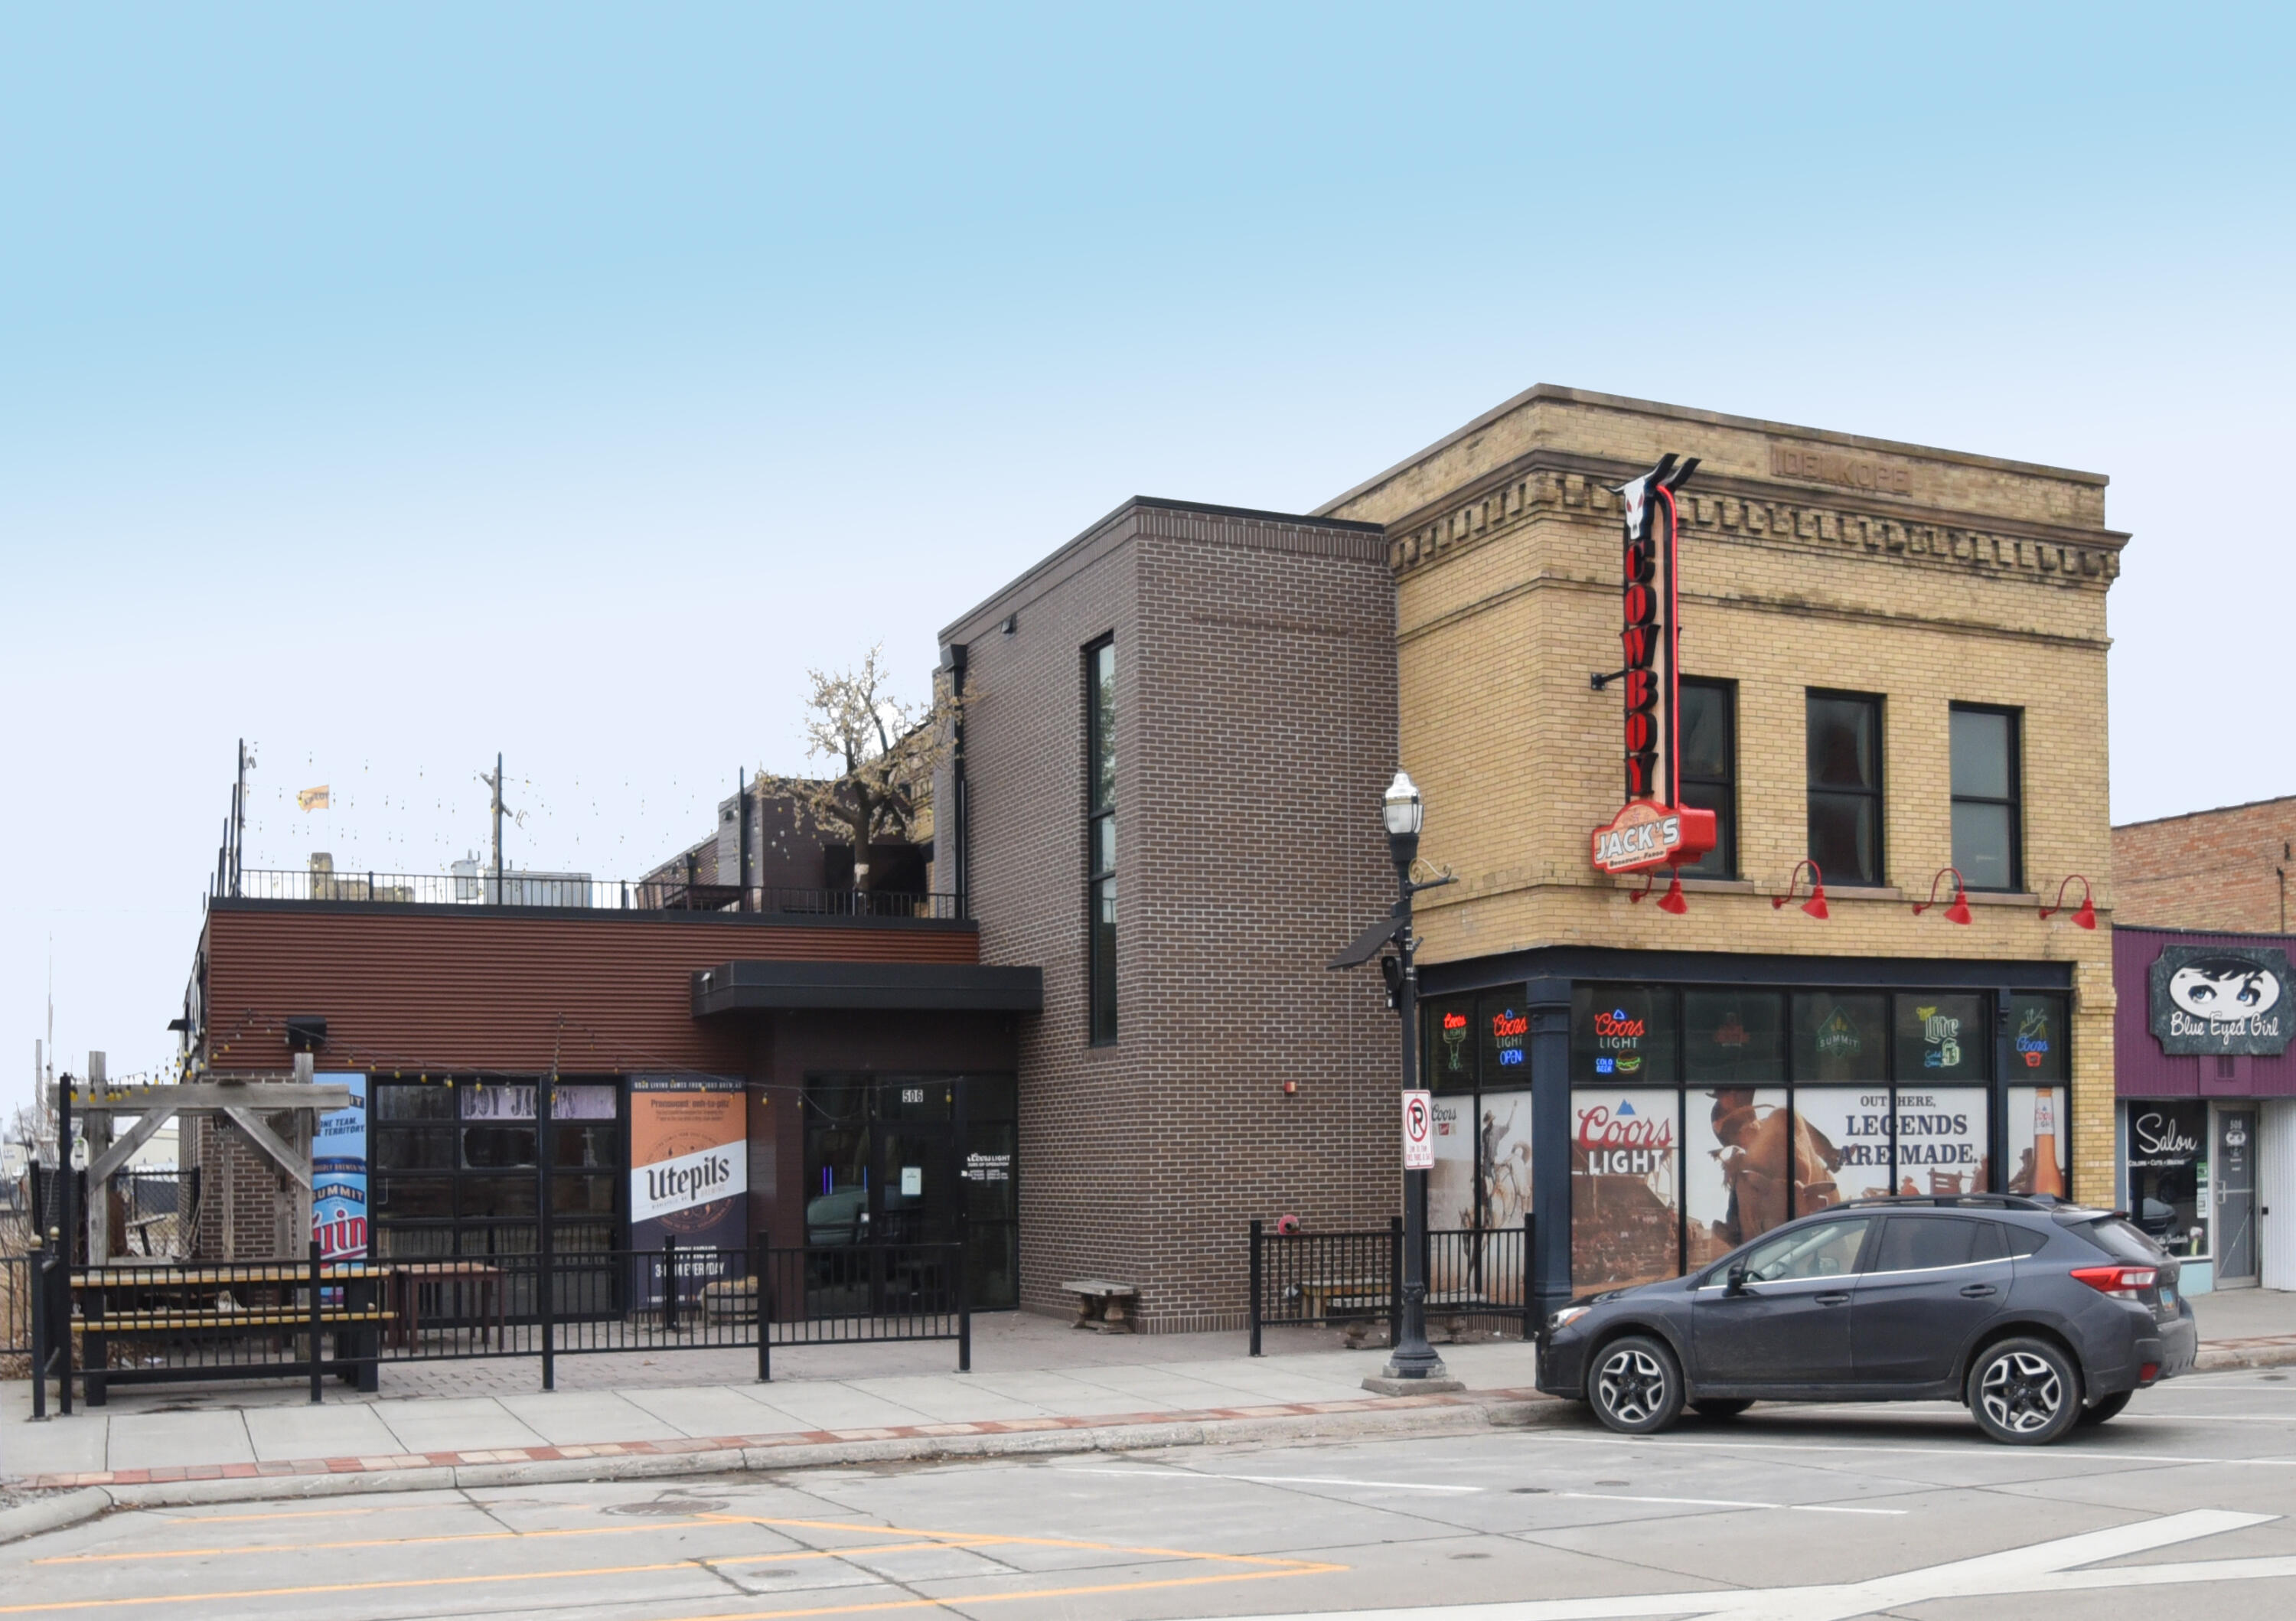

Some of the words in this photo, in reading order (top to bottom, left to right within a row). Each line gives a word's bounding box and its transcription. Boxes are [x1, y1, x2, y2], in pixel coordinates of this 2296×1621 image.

[1620, 540, 1658, 793] COWBOY
[1596, 816, 1679, 861] JACK'S
[1493, 1013, 1528, 1037] Coors
[1595, 1013, 1645, 1036] Coors
[1924, 1016, 1959, 1044] Lite
[2170, 1011, 2204, 1036] Blue
[2210, 1010, 2245, 1045] Eyed
[2251, 1012, 2278, 1036] Girl
[1496, 1036, 1522, 1049] LIGHT
[1600, 1037, 1639, 1049] LIGHT
[1819, 1035, 1859, 1048] SUMMIT
[2016, 1036, 2049, 1052] Coors
[1500, 1049, 1521, 1065] OPEN
[904, 1090, 922, 1102] 506
[1861, 1095, 1887, 1107] OUT
[1897, 1095, 1936, 1108] HERE,
[1577, 1105, 1673, 1150] Coors
[2136, 1113, 2198, 1153] Salon
[1589, 1150, 1663, 1176] LIGHT
[1838, 1144, 1890, 1166] ARE
[1900, 1143, 1978, 1165] MADE.
[646, 1154, 730, 1201] Utepils
